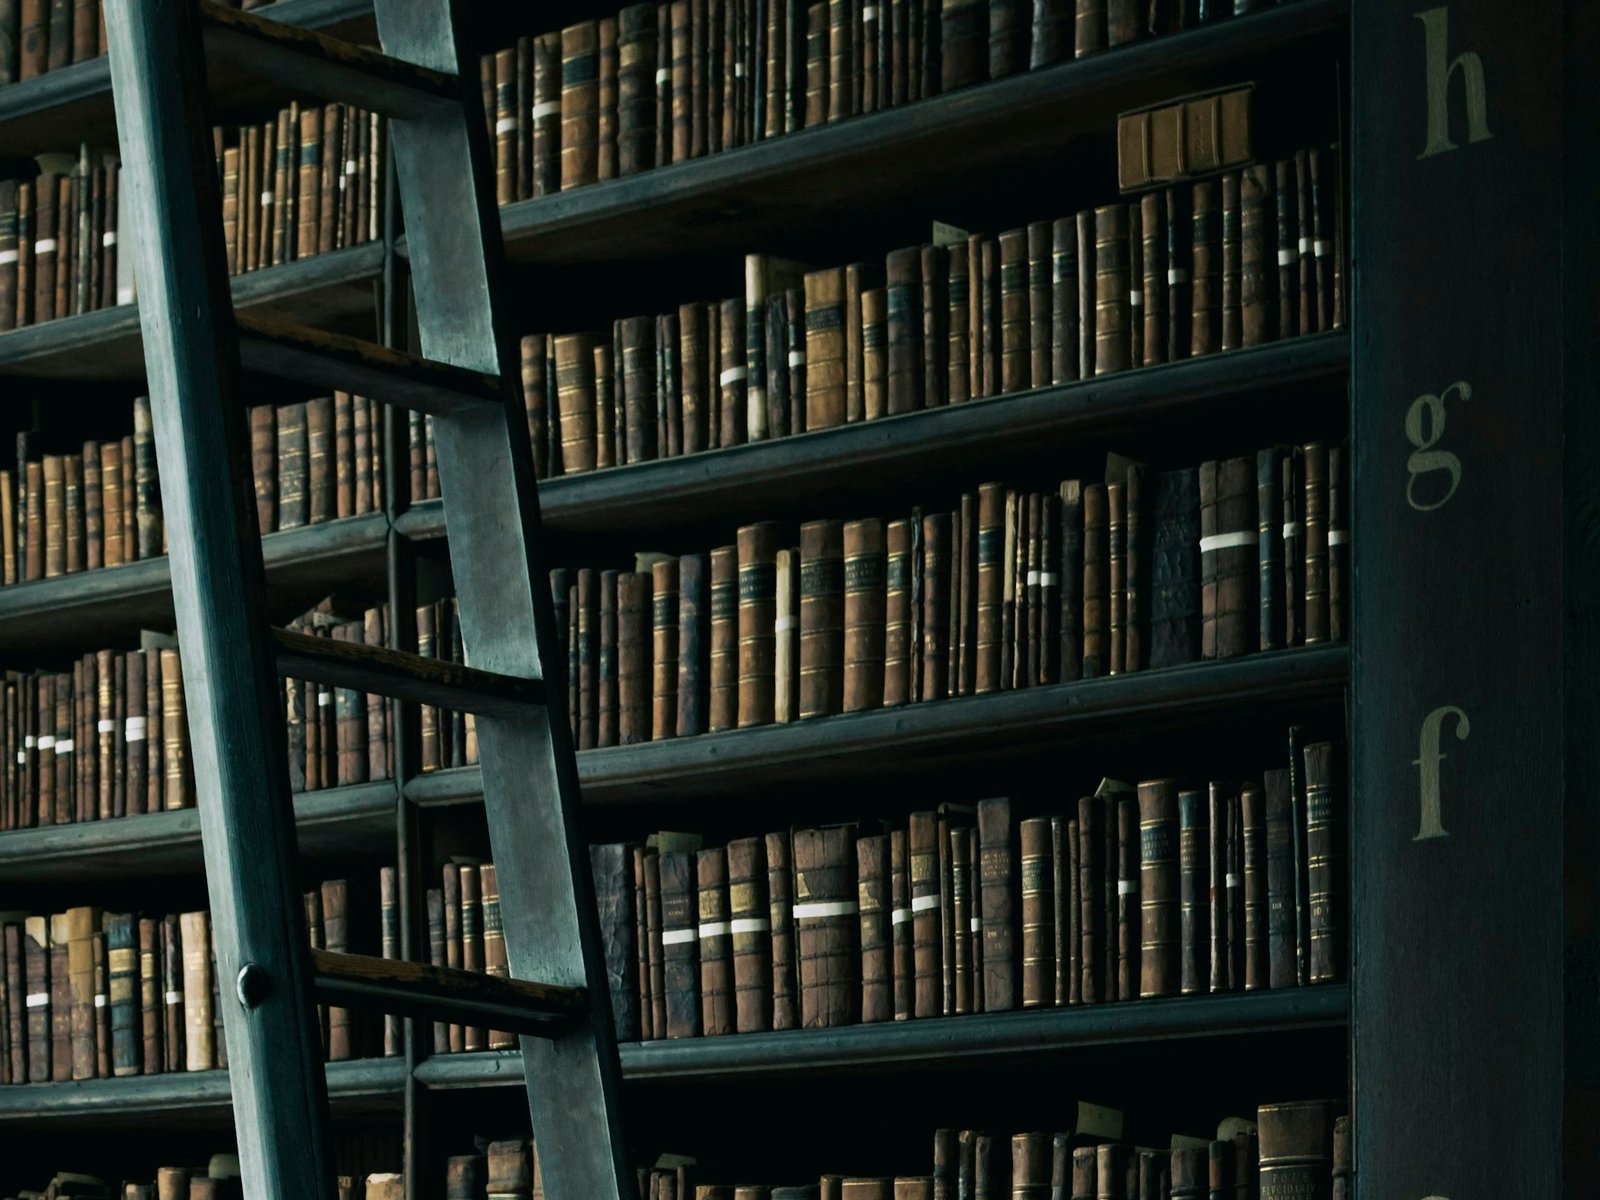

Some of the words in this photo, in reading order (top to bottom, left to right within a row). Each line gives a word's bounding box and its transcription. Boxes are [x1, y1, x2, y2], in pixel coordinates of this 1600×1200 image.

[1415, 7, 1491, 160] h
[1404, 380, 1472, 512] g
[1411, 705, 1471, 843] f
